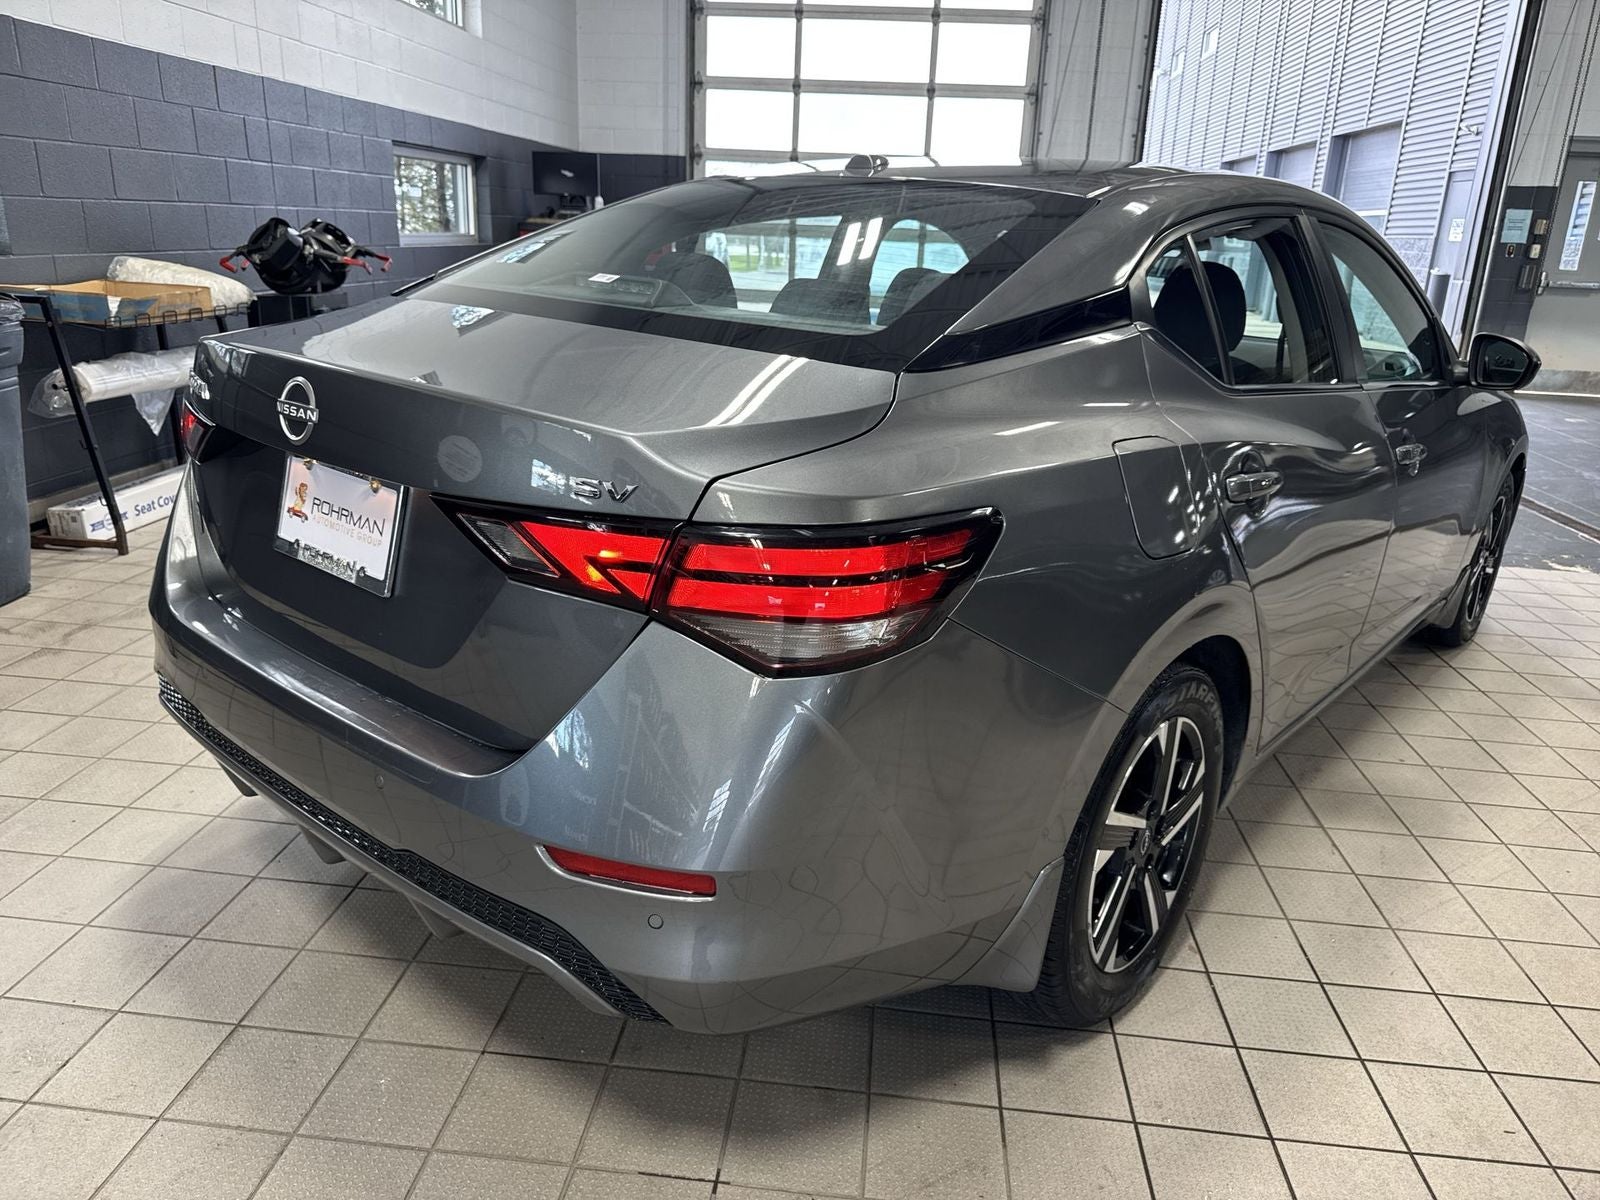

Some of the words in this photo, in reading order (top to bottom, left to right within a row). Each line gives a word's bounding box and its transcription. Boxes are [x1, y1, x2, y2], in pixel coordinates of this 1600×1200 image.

[277, 400, 318, 422] NISSAN
[573, 477, 640, 503] SV
[134, 502, 157, 517] Seat
[311, 497, 386, 537] ROHRMAN
[312, 513, 356, 539] AUTOMOTIVE
[357, 531, 383, 546] GROUP
